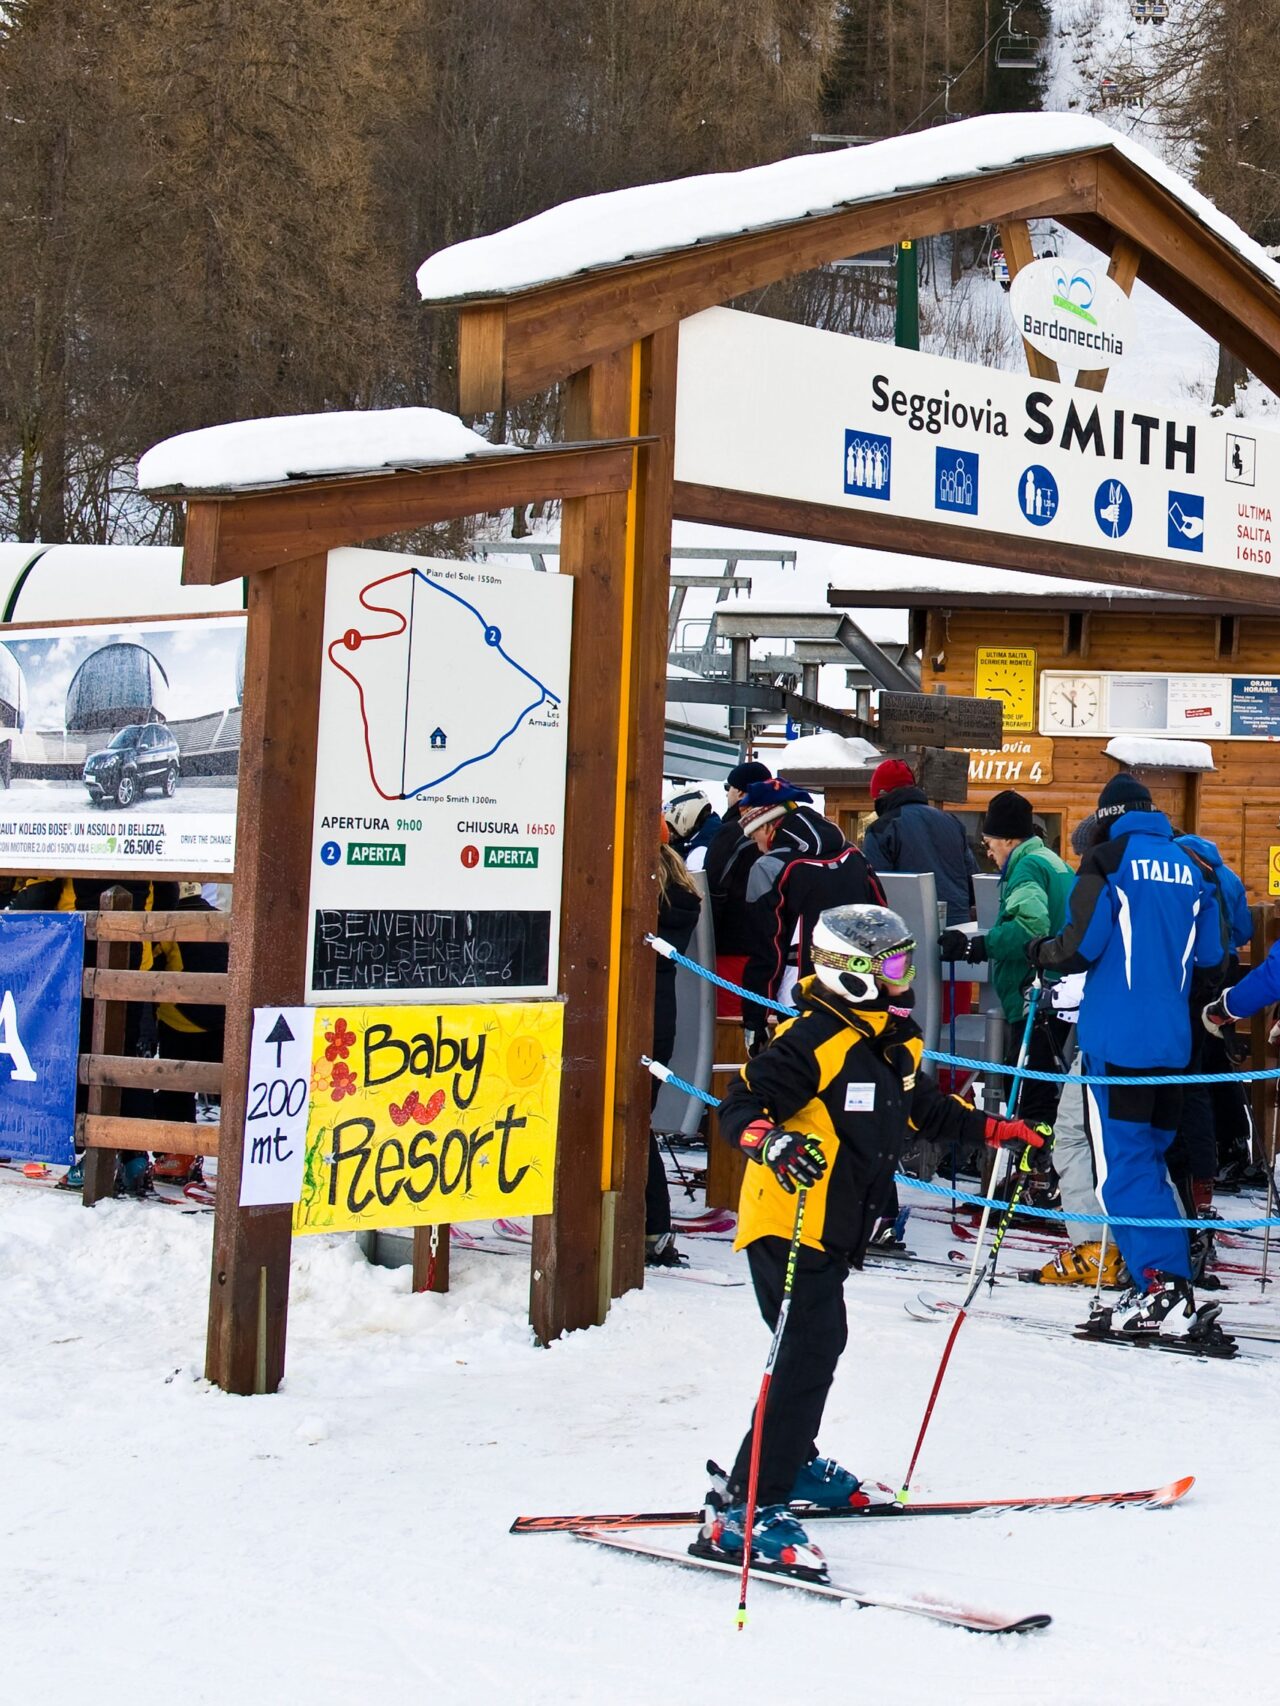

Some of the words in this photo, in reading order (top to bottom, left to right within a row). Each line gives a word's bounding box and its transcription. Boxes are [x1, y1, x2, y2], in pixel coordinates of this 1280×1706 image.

[1024, 314, 1123, 355] Bardonecchia
[871, 374, 1009, 437] Seggiovia
[1023, 391, 1196, 474] SMITH
[1237, 503, 1272, 522] ULTIMA
[1237, 524, 1271, 543] SALITA
[1236, 546, 1272, 564] 16h50
[426, 569, 443, 578] Pian
[444, 571, 457, 579] del
[458, 572, 475, 582] Sole
[477, 574, 502, 585] 1550m
[489, 630, 496, 641] 2
[1243, 686, 1278, 694] HORAIRES
[528, 718, 559, 728] Arnauds
[547, 711, 560, 719] Les
[1002, 720, 1031, 728] ERGFAHRT
[968, 760, 1022, 780] MITH
[1029, 761, 1042, 783] 4
[415, 794, 444, 804] Campo
[446, 794, 469, 804] Smith
[472, 796, 497, 805] 1300m
[0, 823, 17, 835] AULT
[19, 823, 47, 836] KOLEOS
[74, 823, 85, 836] UN
[86, 823, 116, 836] ASSOLO
[118, 824, 126, 836] DI
[321, 816, 390, 831] APERTURA
[396, 819, 422, 832] 9h00
[457, 821, 519, 835] CHIUSURA
[526, 823, 556, 836] 16h50
[10, 842, 35, 853] MOTORE
[180, 835, 197, 844] DRIVE
[198, 835, 208, 844] THE
[210, 835, 232, 845] CHANGE
[327, 847, 335, 860] 2
[351, 847, 401, 862] APERTA
[488, 850, 534, 865] APERTA
[1131, 859, 1193, 886] ITALIA
[320, 909, 456, 940] BENVENUTI
[323, 940, 385, 963] TEMPO
[392, 937, 493, 963] SERENO
[320, 961, 477, 988] TEMPERATURA
[364, 1016, 487, 1110] Baby
[248, 1078, 307, 1121] 200
[250, 1127, 294, 1164] mt
[804, 1143, 826, 1165] LEKI
[328, 1104, 531, 1214] Resort
[784, 1251, 797, 1292] LEKI
